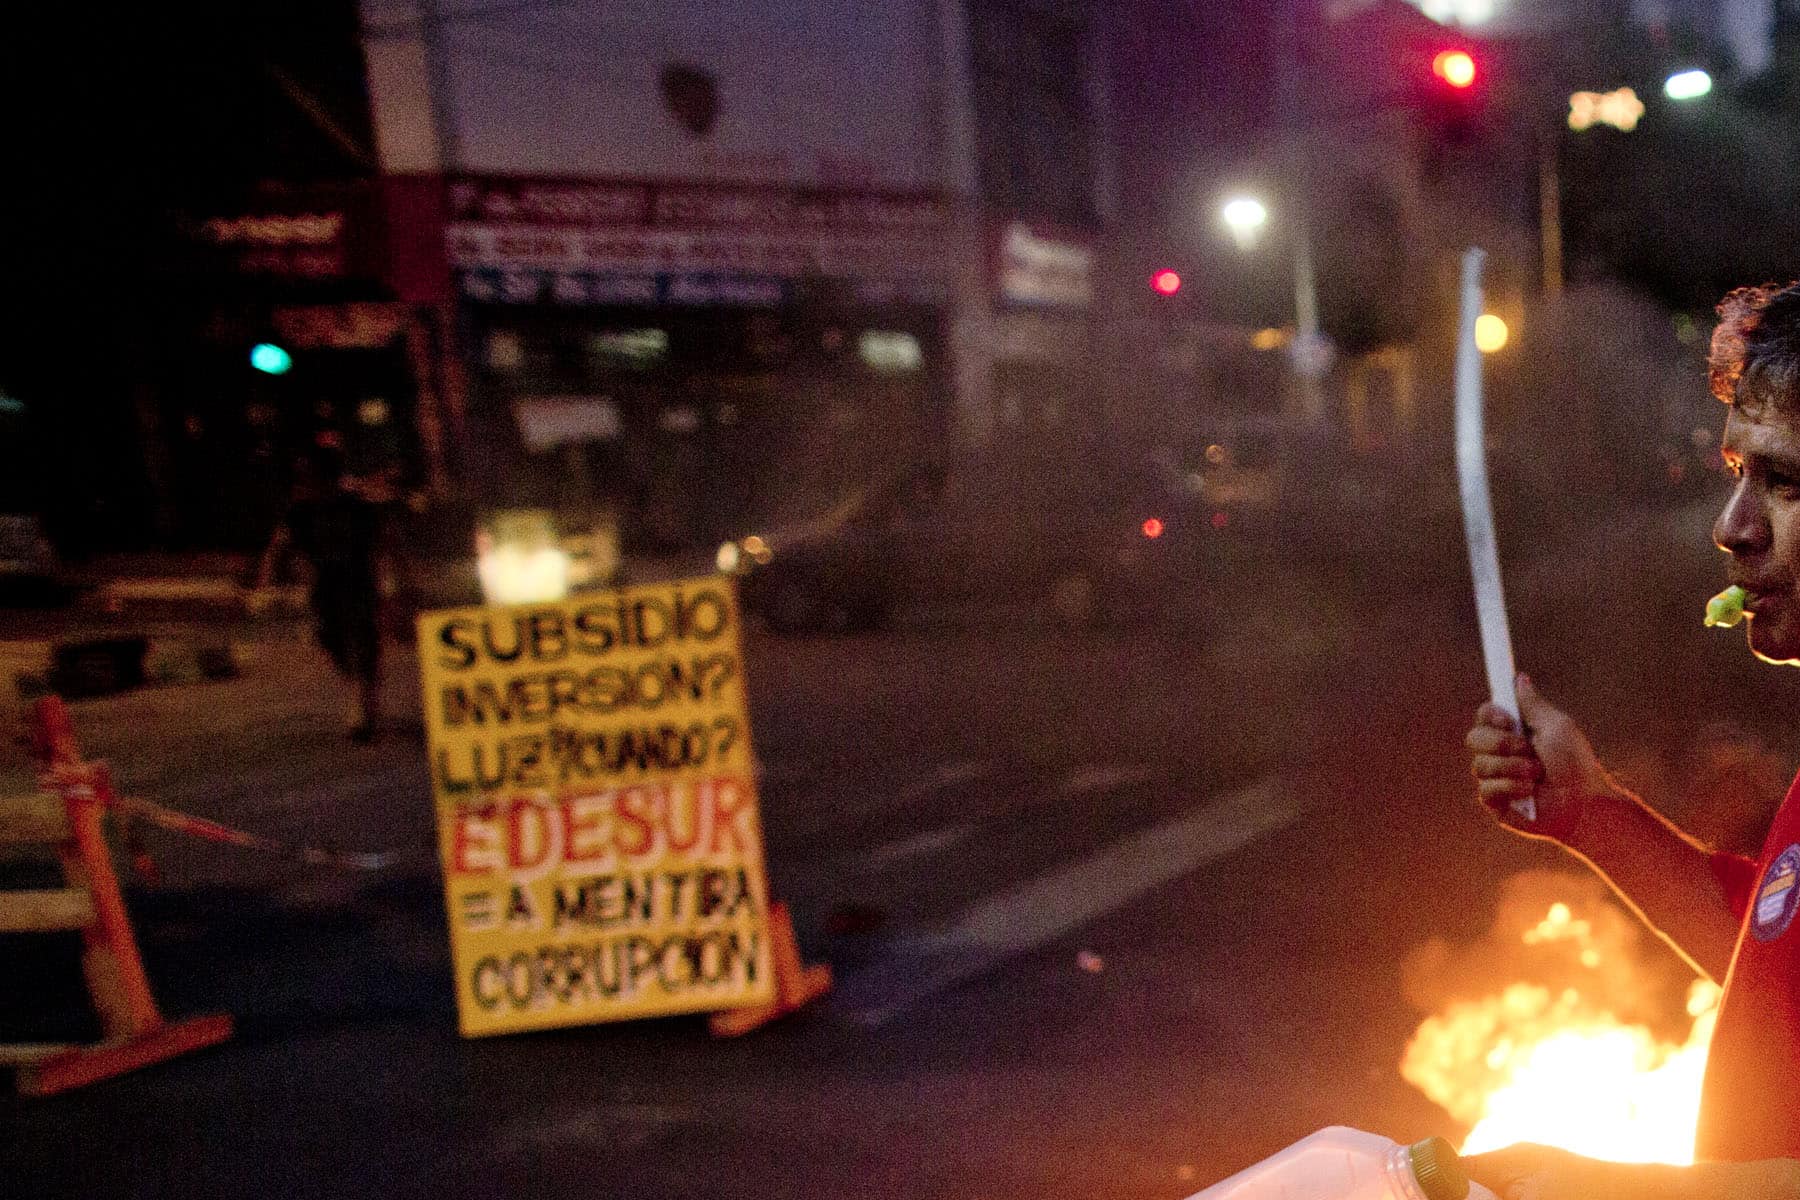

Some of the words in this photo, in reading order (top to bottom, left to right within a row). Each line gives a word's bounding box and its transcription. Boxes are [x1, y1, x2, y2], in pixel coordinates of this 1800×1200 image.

[437, 588, 730, 672] SUBSIDIO
[450, 774, 748, 876] EDESUR
[471, 928, 761, 1012] CORRUPCION
